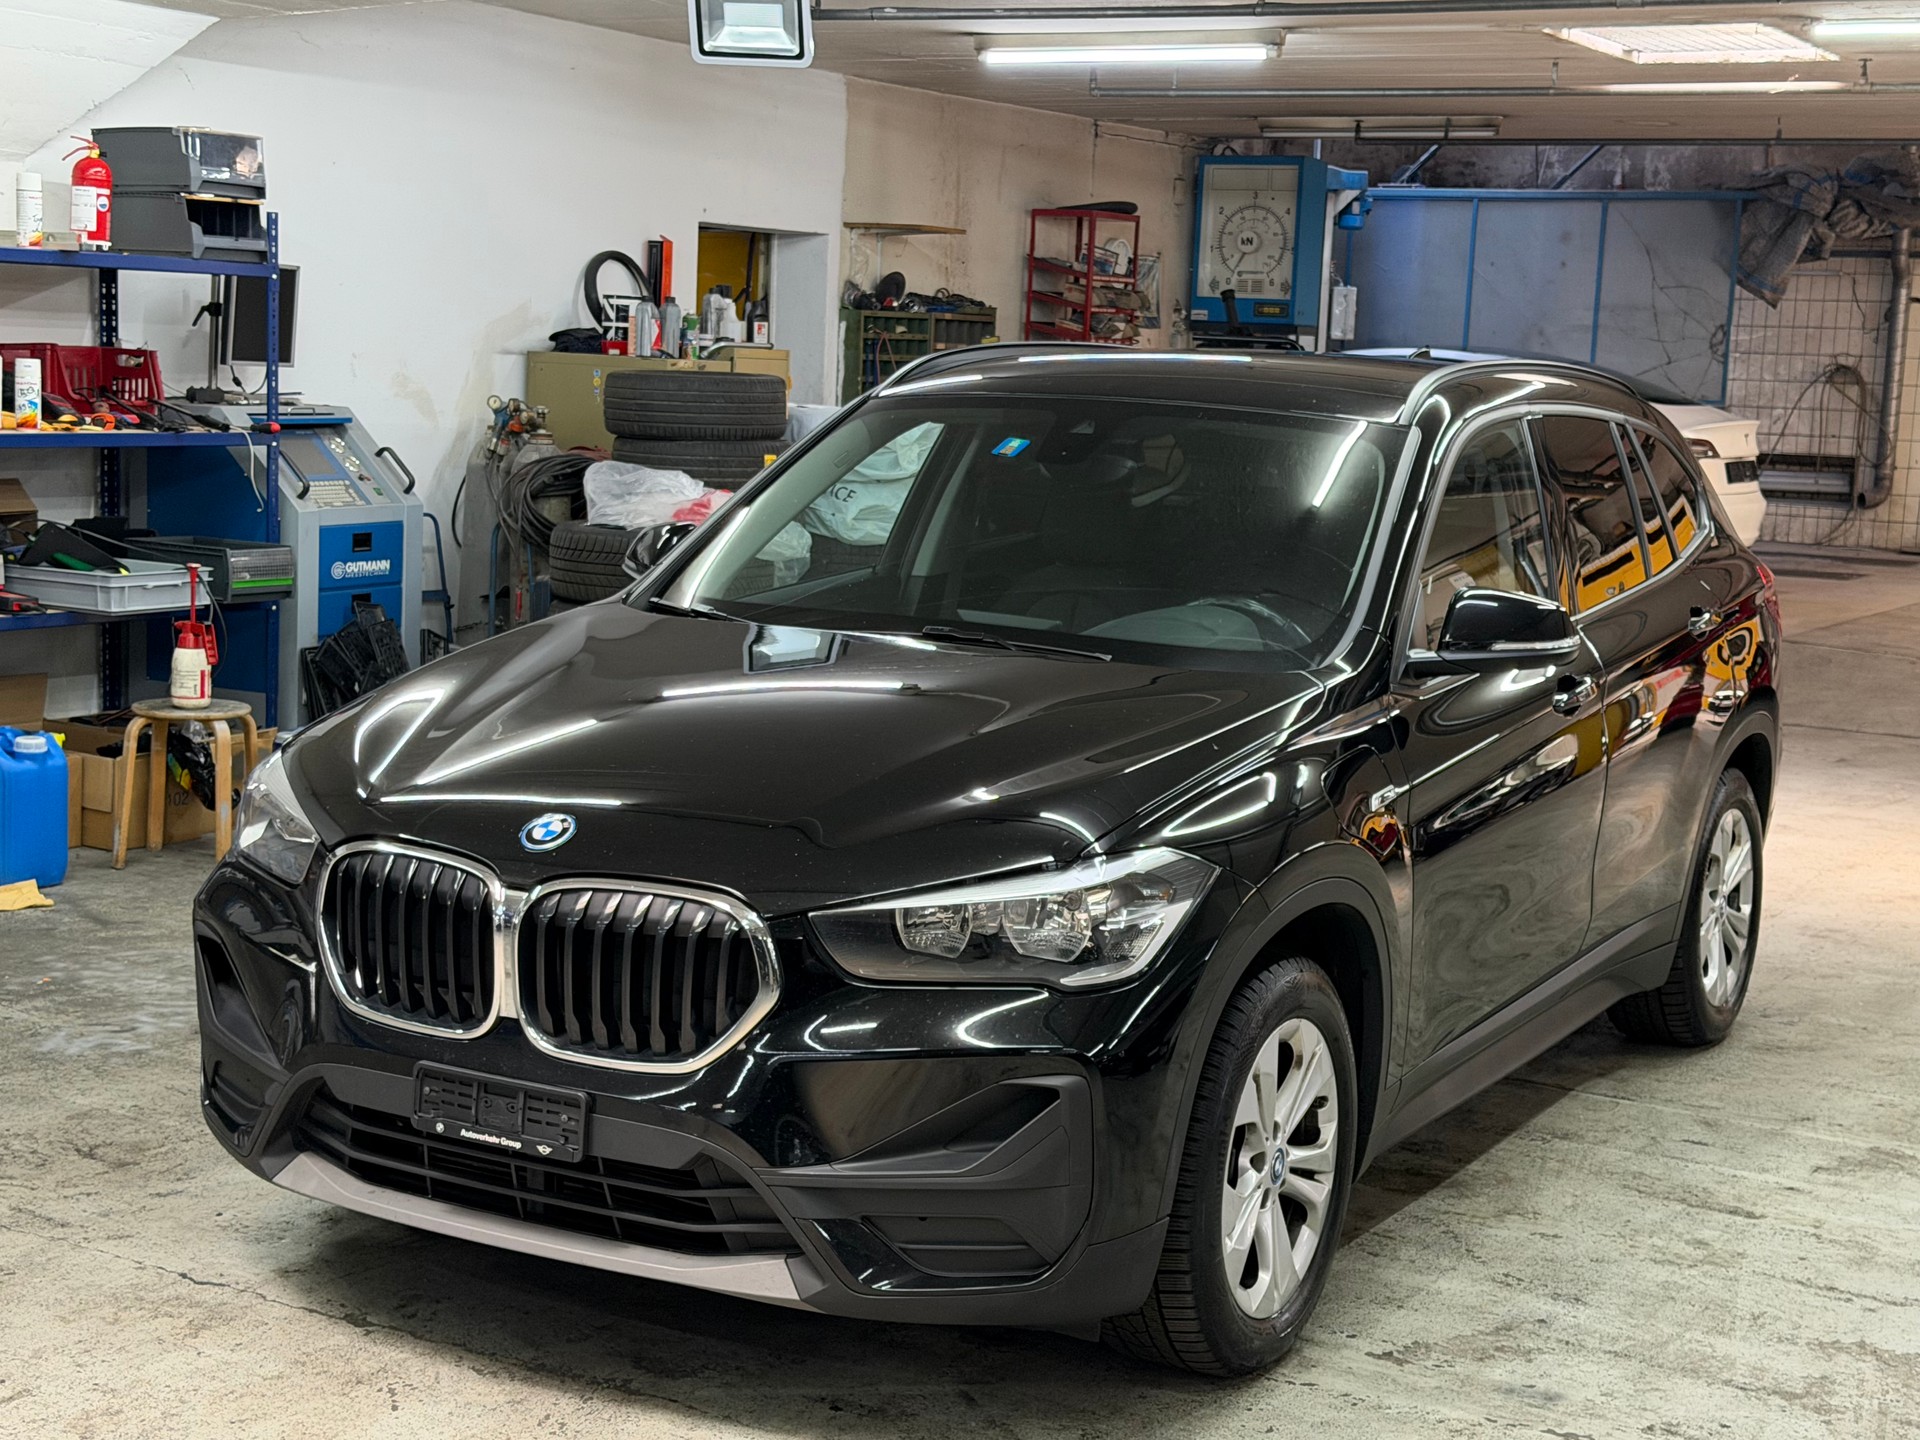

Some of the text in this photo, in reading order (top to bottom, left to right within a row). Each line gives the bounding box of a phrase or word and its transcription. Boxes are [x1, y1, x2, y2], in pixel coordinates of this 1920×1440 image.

[1240, 236, 1254, 246] kN
[345, 559, 391, 572] GUTMANN
[460, 1128, 522, 1149] Autoverkehr Group
